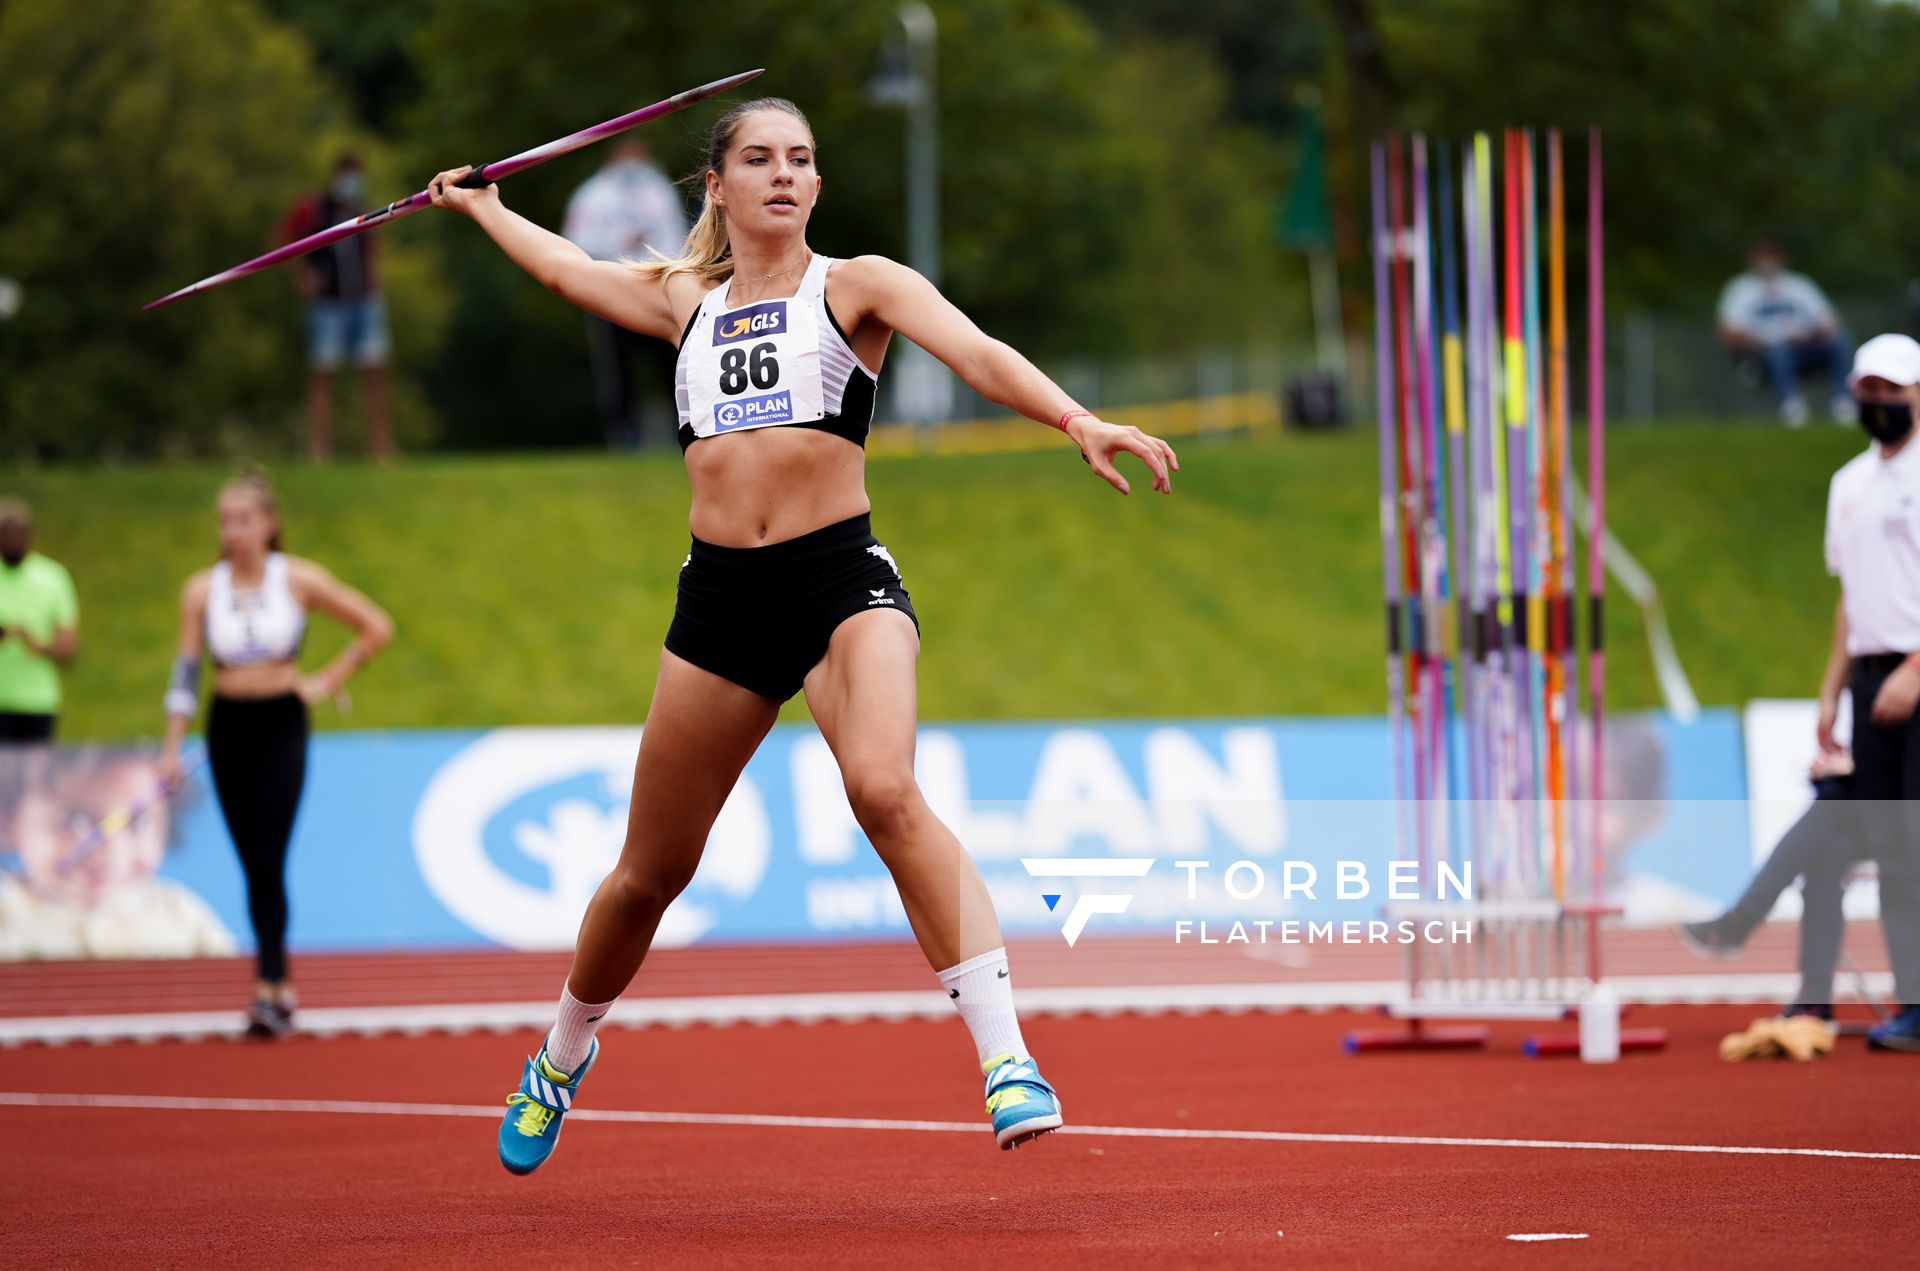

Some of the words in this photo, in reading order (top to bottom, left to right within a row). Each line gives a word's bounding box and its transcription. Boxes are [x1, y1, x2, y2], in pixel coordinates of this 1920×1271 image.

[751, 311, 780, 332] GLS
[719, 342, 780, 395] 86
[746, 397, 788, 416] PLAN
[746, 411, 789, 422] INTERNATIONAL
